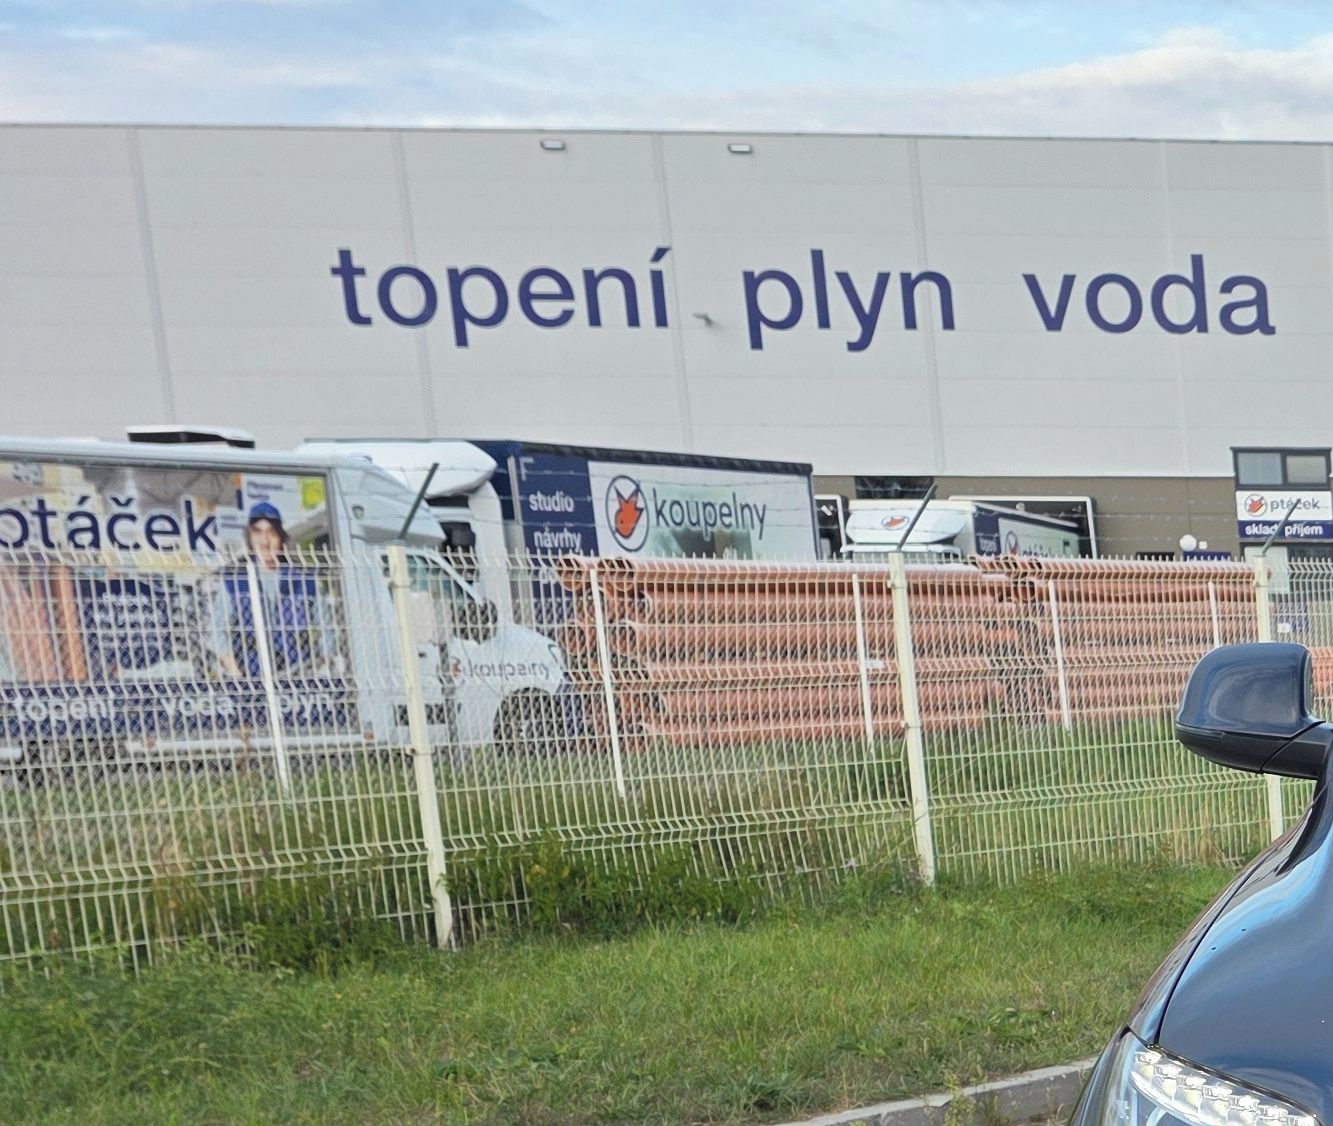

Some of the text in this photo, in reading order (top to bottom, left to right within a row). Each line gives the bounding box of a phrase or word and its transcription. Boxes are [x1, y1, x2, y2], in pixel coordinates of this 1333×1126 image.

[330, 246, 1276, 353] topení plyn voda
[529, 491, 575, 513] studio
[652, 487, 767, 541] koupelny
[534, 528, 582, 555] návrhy
[1245, 523, 1323, 537] sklad příjem
